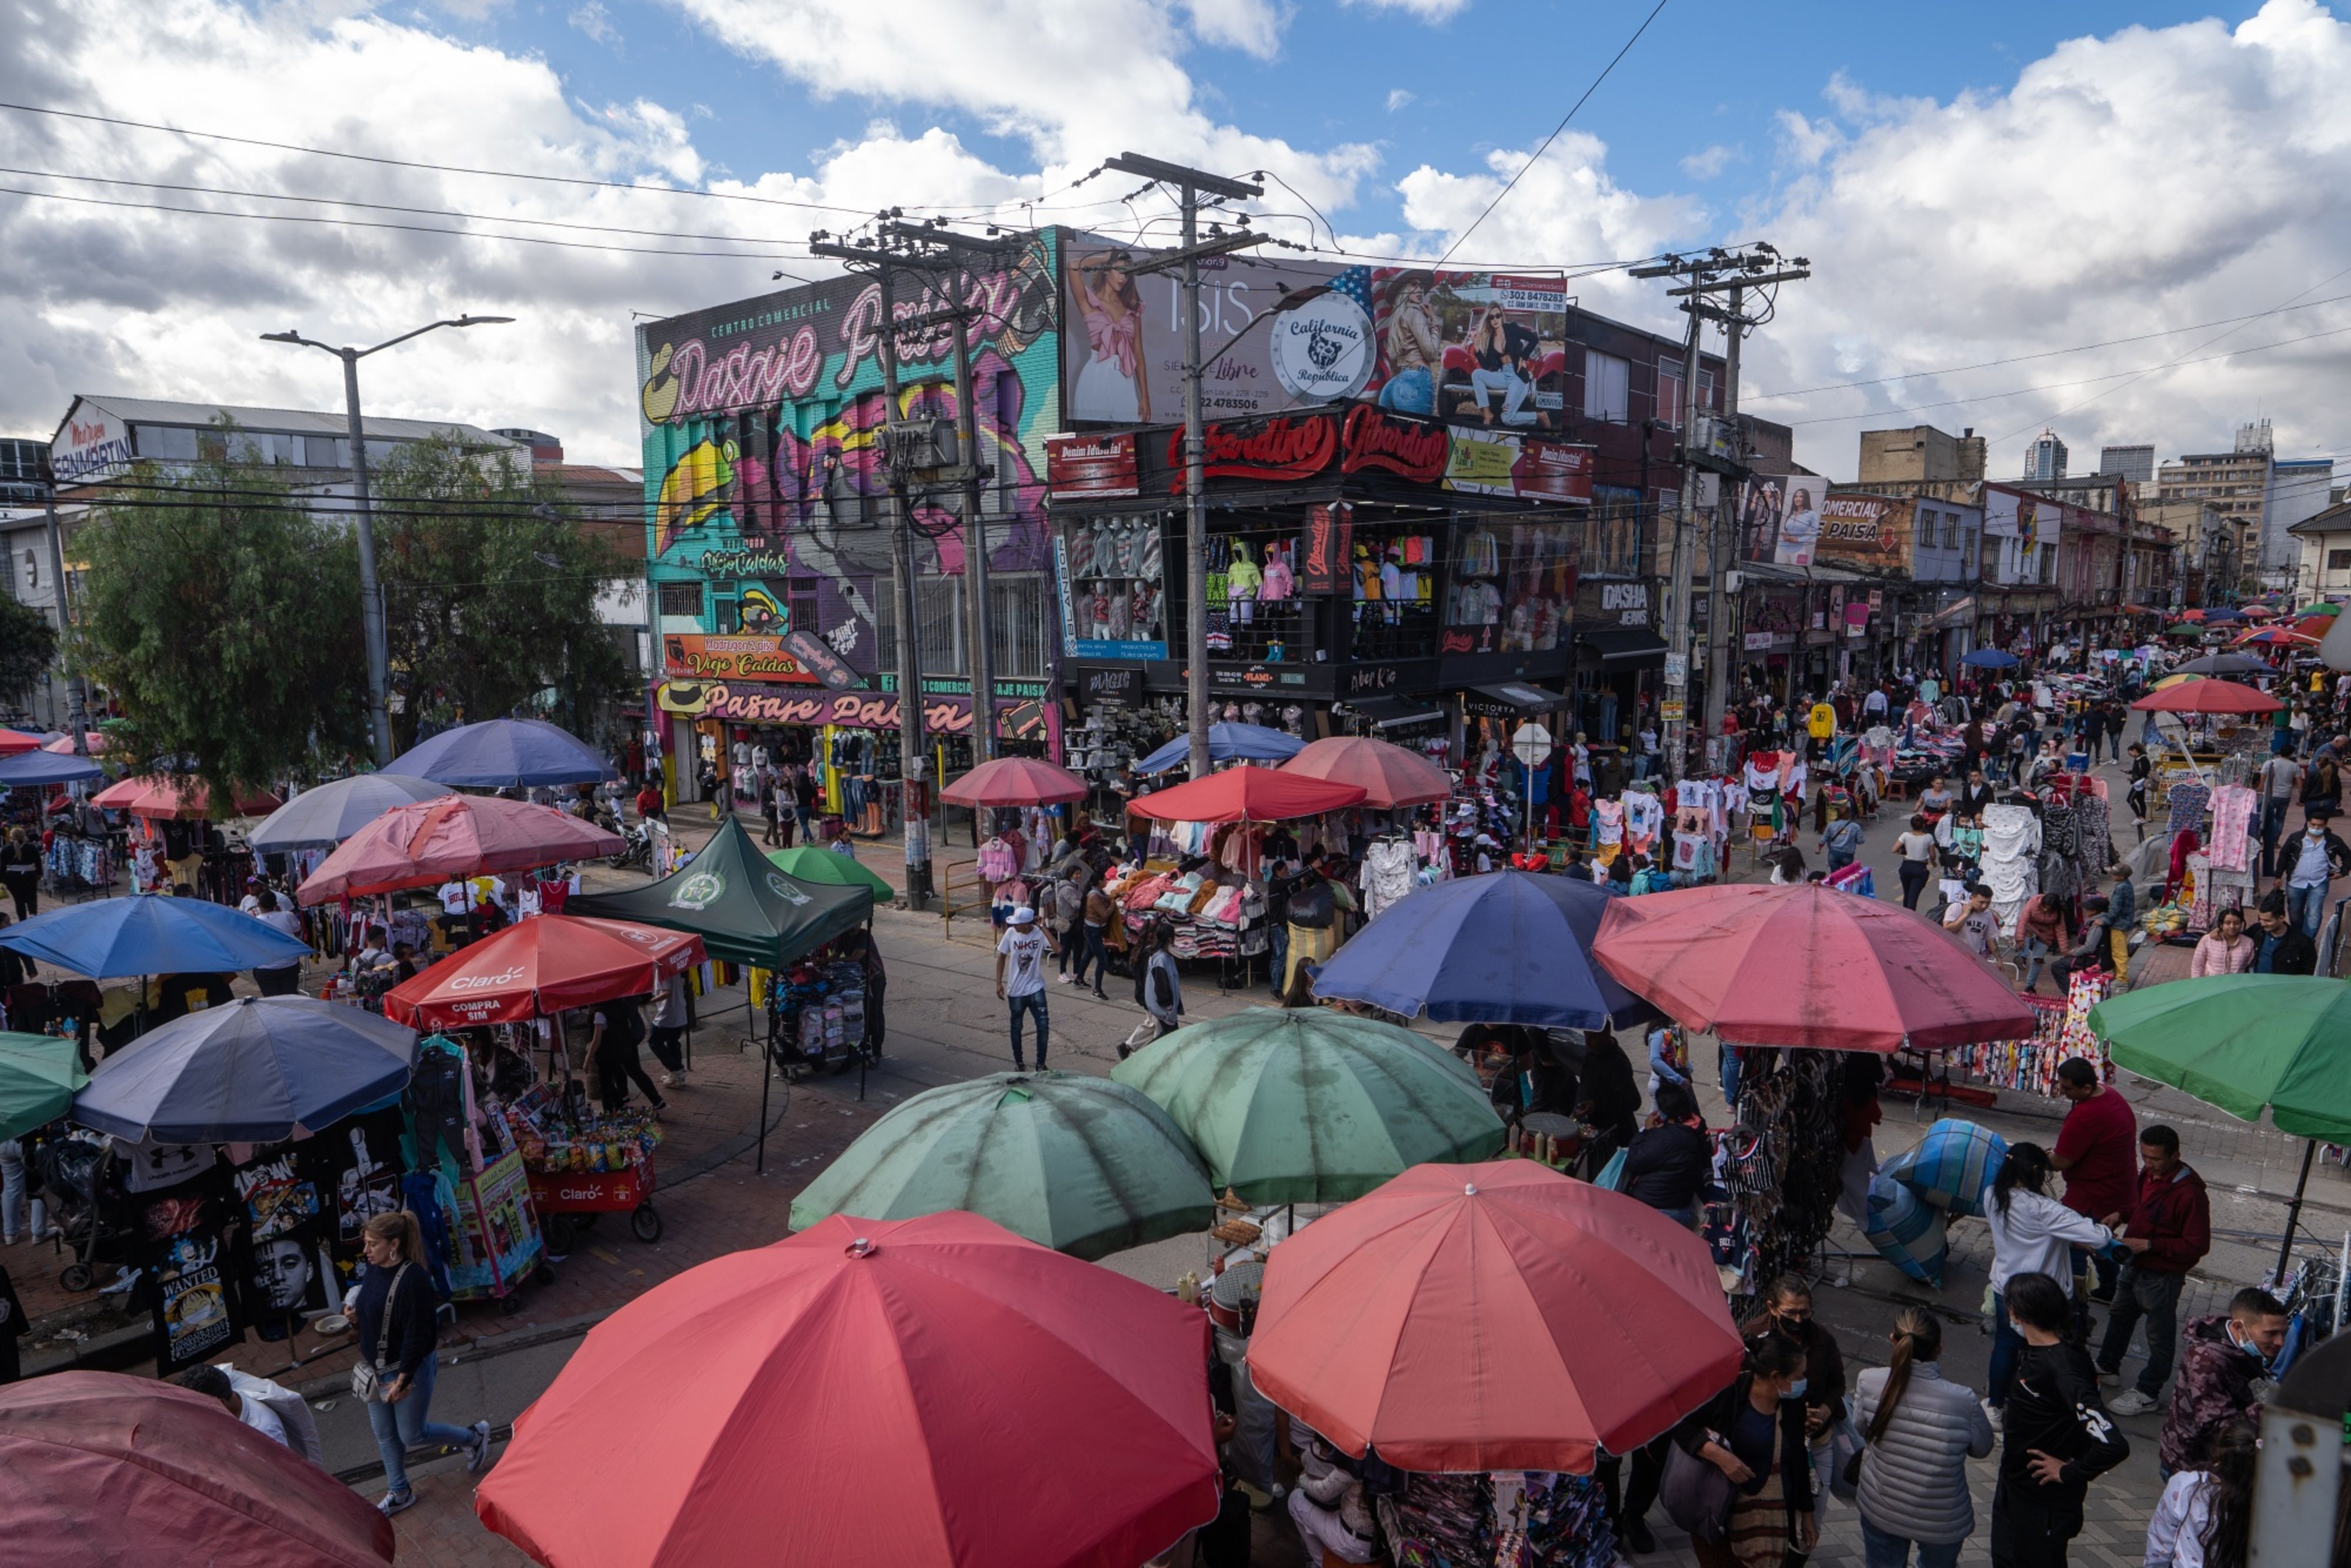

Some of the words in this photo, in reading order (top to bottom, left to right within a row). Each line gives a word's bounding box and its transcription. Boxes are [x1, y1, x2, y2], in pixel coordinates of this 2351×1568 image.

[1510, 291, 1525, 300] 302
[1528, 293, 1563, 302] 8478283
[712, 318, 754, 338] CENTRO
[759, 298, 830, 327] COMERCIAL
[1290, 319, 1358, 339] California
[670, 325, 821, 423] Pasaje
[1215, 357, 1259, 380] Libre
[1201, 398, 1211, 407] 22
[1214, 398, 1258, 409] 4783506
[1061, 445, 1086, 458] Denim
[1821, 500, 1877, 519] OMERCIAL
[1826, 521, 1878, 541] PAISA
[735, 549, 789, 576] Caldas
[1619, 609, 1647, 626] JEANS
[757, 640, 775, 653] piso
[687, 653, 732, 678] Viejo
[736, 653, 796, 676] Caldas
[929, 683, 970, 694] COMERCIA
[1016, 684, 1044, 696] PAISA
[705, 685, 822, 722] Pasaje
[831, 696, 973, 731] Paia
[1468, 703, 1515, 714] VICTORYA
[1014, 940, 1038, 950] NIKE
[451, 969, 517, 989] Claro
[451, 999, 501, 1012] COMPRA
[467, 1011, 488, 1021] SIM
[560, 1186, 600, 1199] Claro
[163, 1266, 218, 1298] WANTED
